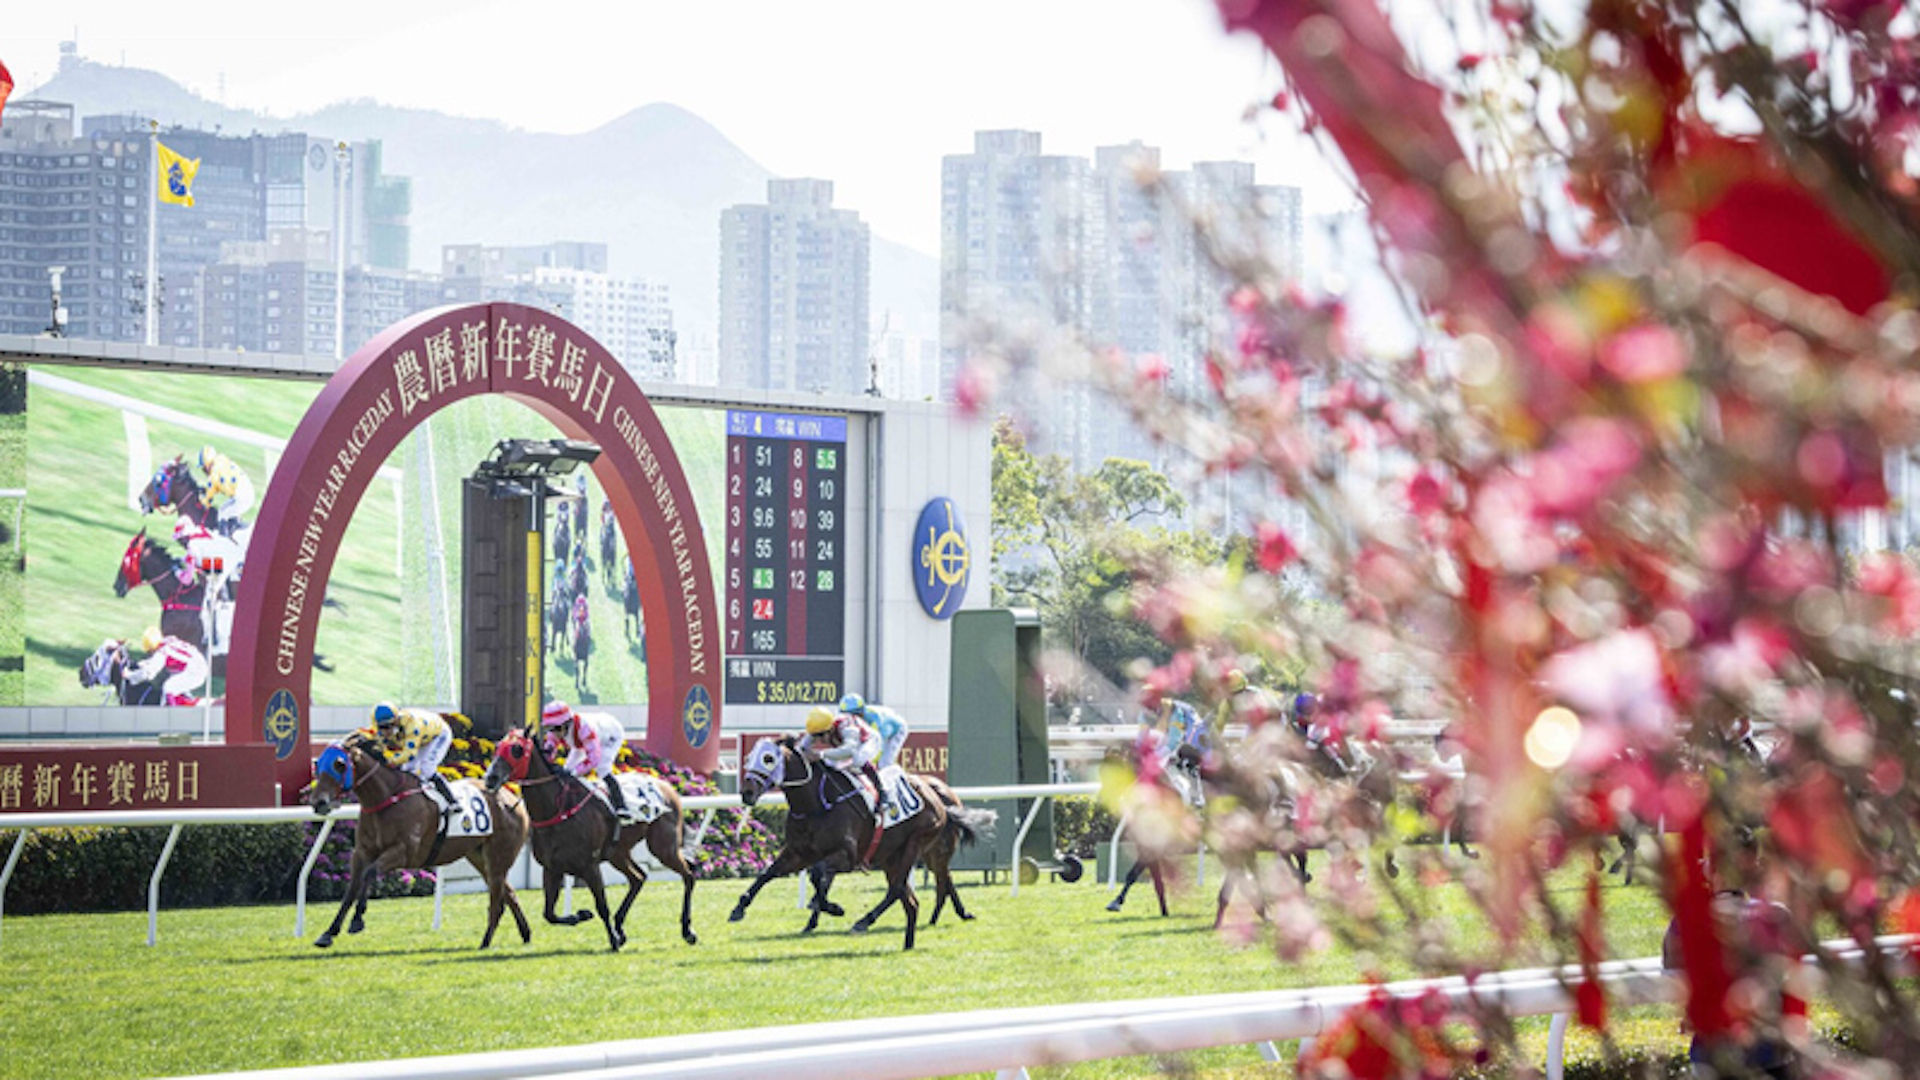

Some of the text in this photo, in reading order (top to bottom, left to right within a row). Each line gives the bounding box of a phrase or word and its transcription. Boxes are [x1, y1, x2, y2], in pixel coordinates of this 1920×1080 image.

[393, 317, 615, 424] 農曆新年賽馬日
[733, 445, 740, 464] 1
[755, 446, 772, 466] 51
[793, 448, 803, 469] 8
[731, 474, 834, 500] 2 24 9 10
[731, 506, 834, 531] 3 9.6 10 39
[277, 388, 395, 675] CHINESE NEW YEAR RACEDAY
[613, 405, 706, 675] CHINESE NEW YEAR RACEDAY
[731, 538, 834, 560] 4 55 11 24
[731, 568, 740, 588] 5
[791, 571, 805, 590] 12
[817, 571, 834, 590] 28
[730, 599, 774, 619] 6 2.4
[731, 631, 776, 651] 7 165
[753, 660, 776, 678] WIN
[757, 681, 836, 704] $ 35,012,770
[471, 796, 490, 832] 8
